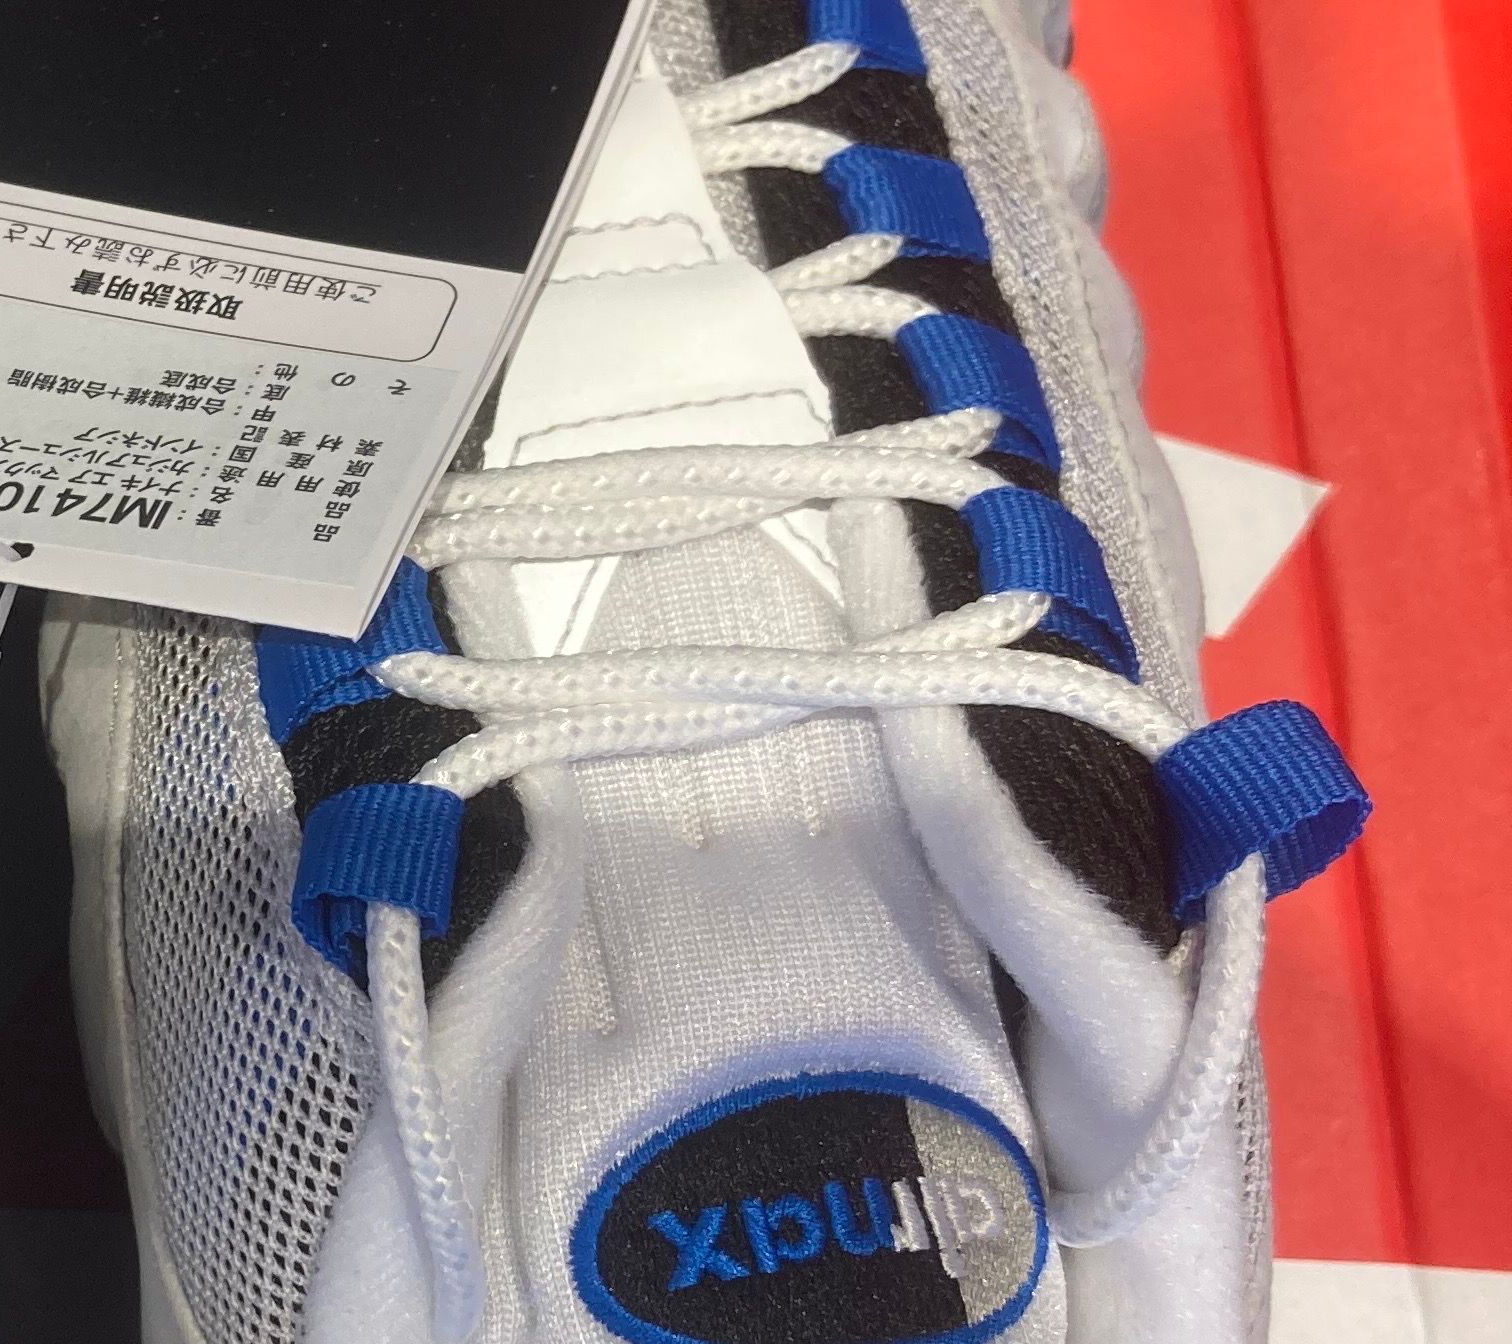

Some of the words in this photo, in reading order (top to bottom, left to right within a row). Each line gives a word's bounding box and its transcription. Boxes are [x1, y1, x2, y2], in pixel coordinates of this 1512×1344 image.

[69, 267, 244, 320] 取扱説明書
